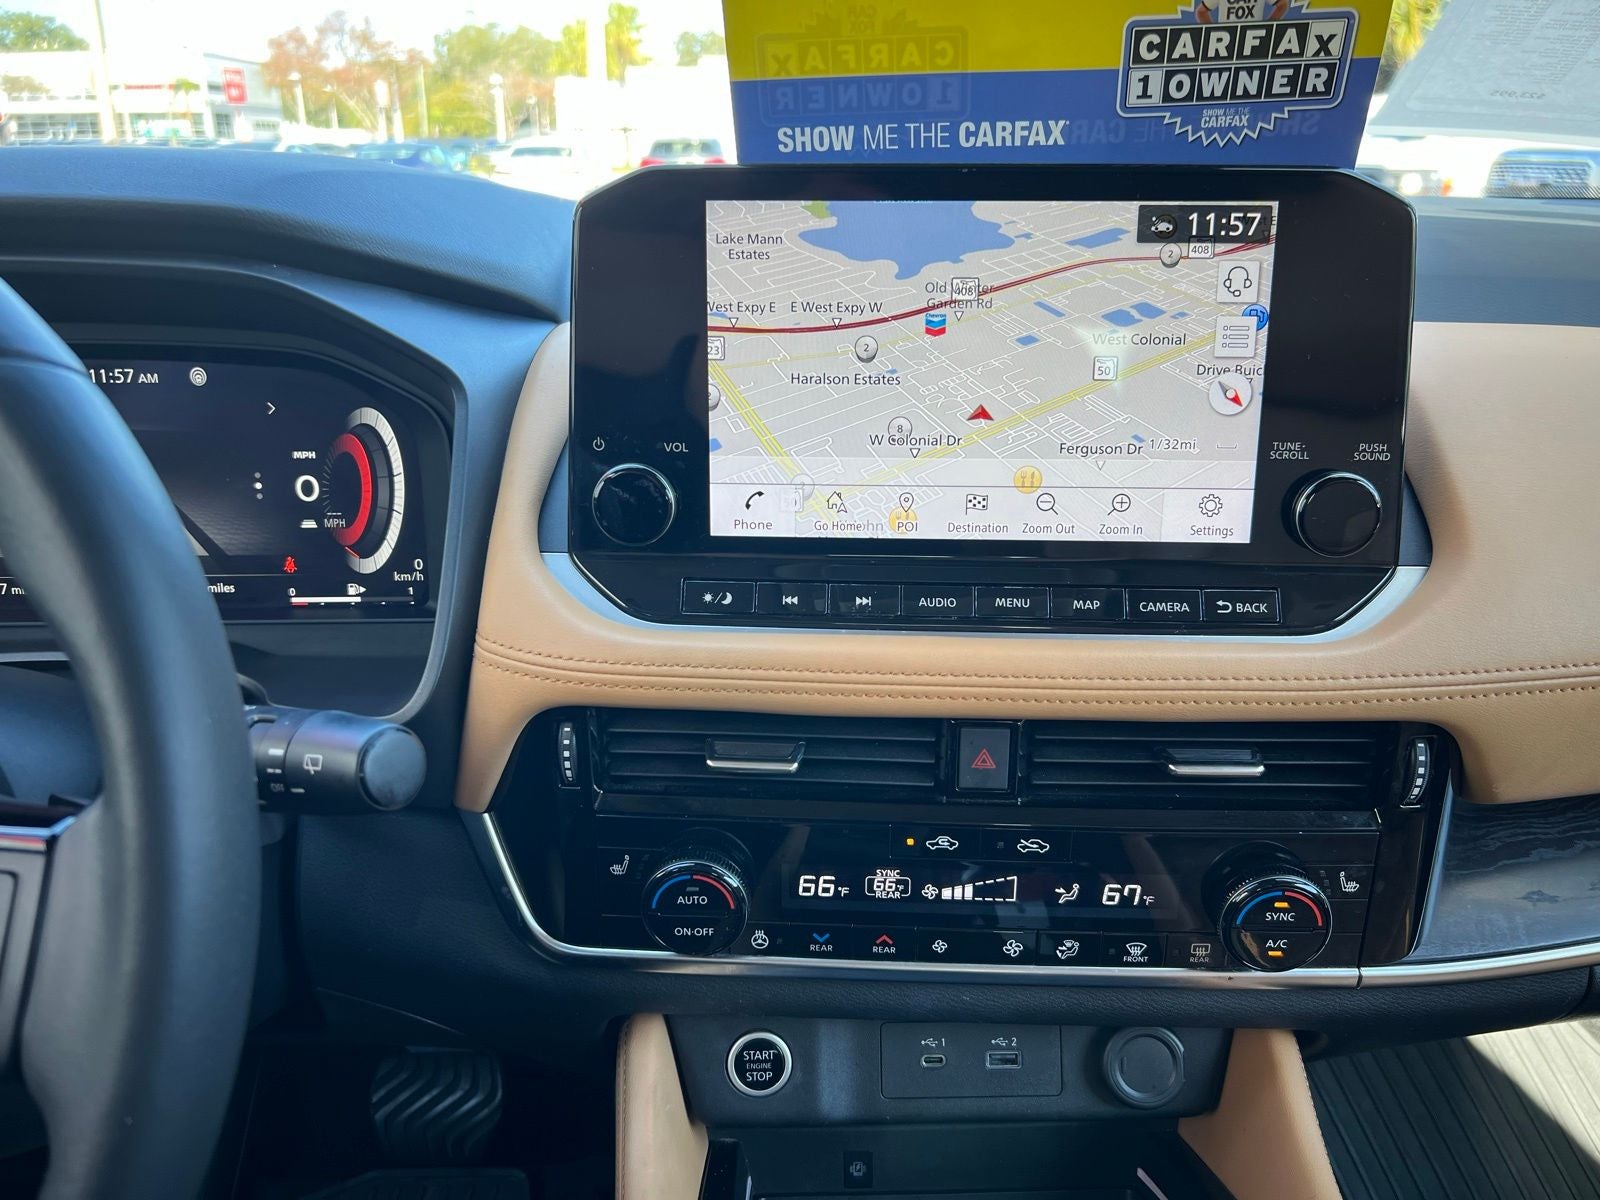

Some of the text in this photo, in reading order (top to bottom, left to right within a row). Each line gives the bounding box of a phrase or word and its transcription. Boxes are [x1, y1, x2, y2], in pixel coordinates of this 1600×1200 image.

[1226, 5, 1256, 20] FOX
[1138, 28, 1338, 61] CARFAX
[1202, 108, 1225, 117] SHOW
[1201, 115, 1250, 128] CARFAX
[777, 120, 1066, 153] SHOW ME THE CARFAX
[1188, 212, 1262, 236] 11:57
[715, 233, 783, 245] Lake Mann
[728, 249, 770, 260] Estates
[1167, 250, 1174, 258] 2
[1191, 244, 1210, 255] 408
[925, 281, 947, 294] Old
[737, 301, 766, 314] Expy
[769, 302, 776, 313] E
[791, 301, 883, 314] E West Expy W
[926, 297, 993, 309] Garden Rd
[1092, 333, 1187, 346] West Colonial
[863, 344, 870, 353] 2
[89, 368, 159, 384] 11:57 AM
[1097, 366, 1111, 376] 50
[1196, 364, 1231, 377] Drive
[790, 373, 902, 385] Haralson Estates
[897, 424, 904, 434] 8
[869, 434, 962, 446] W Colonial Dr
[663, 442, 689, 453] VOL
[1059, 442, 1144, 456] Ferguson Dr
[1359, 443, 1388, 452] PUSH
[292, 451, 316, 460] MPH
[1269, 450, 1309, 460] SCROLL
[1353, 452, 1391, 461] SOUND
[294, 474, 320, 502] 0
[324, 519, 346, 528] MPH
[734, 519, 773, 530] Phone
[814, 520, 863, 531] Go Home
[897, 521, 918, 532] POI
[947, 522, 1009, 534] Destination
[1022, 523, 1075, 534] Zoom Out
[1099, 523, 1143, 535] Zoom In
[1190, 525, 1234, 538] Settings
[413, 558, 424, 570] 0
[394, 571, 424, 582] km/h
[207, 582, 236, 593] miles
[288, 587, 296, 597] 0
[918, 597, 957, 608] AUDIO
[994, 597, 1030, 608] MENU
[1072, 599, 1101, 610] MAP
[1139, 601, 1190, 612] CAMERA
[1236, 602, 1268, 613] BACK
[876, 869, 901, 877] SYNC
[677, 895, 708, 905] AUTO
[875, 891, 901, 899] REAR
[1265, 911, 1296, 922] SYNC
[809, 943, 833, 952] REAR
[872, 945, 896, 954] REAR
[1265, 939, 1289, 949] A/C
[1123, 955, 1149, 963] FRONT
[941, 1038, 946, 1047] 1
[1011, 1037, 1017, 1046] 2
[743, 1049, 775, 1061] START
[746, 1062, 772, 1070] ENGINE
[746, 1071, 773, 1081] STOP
